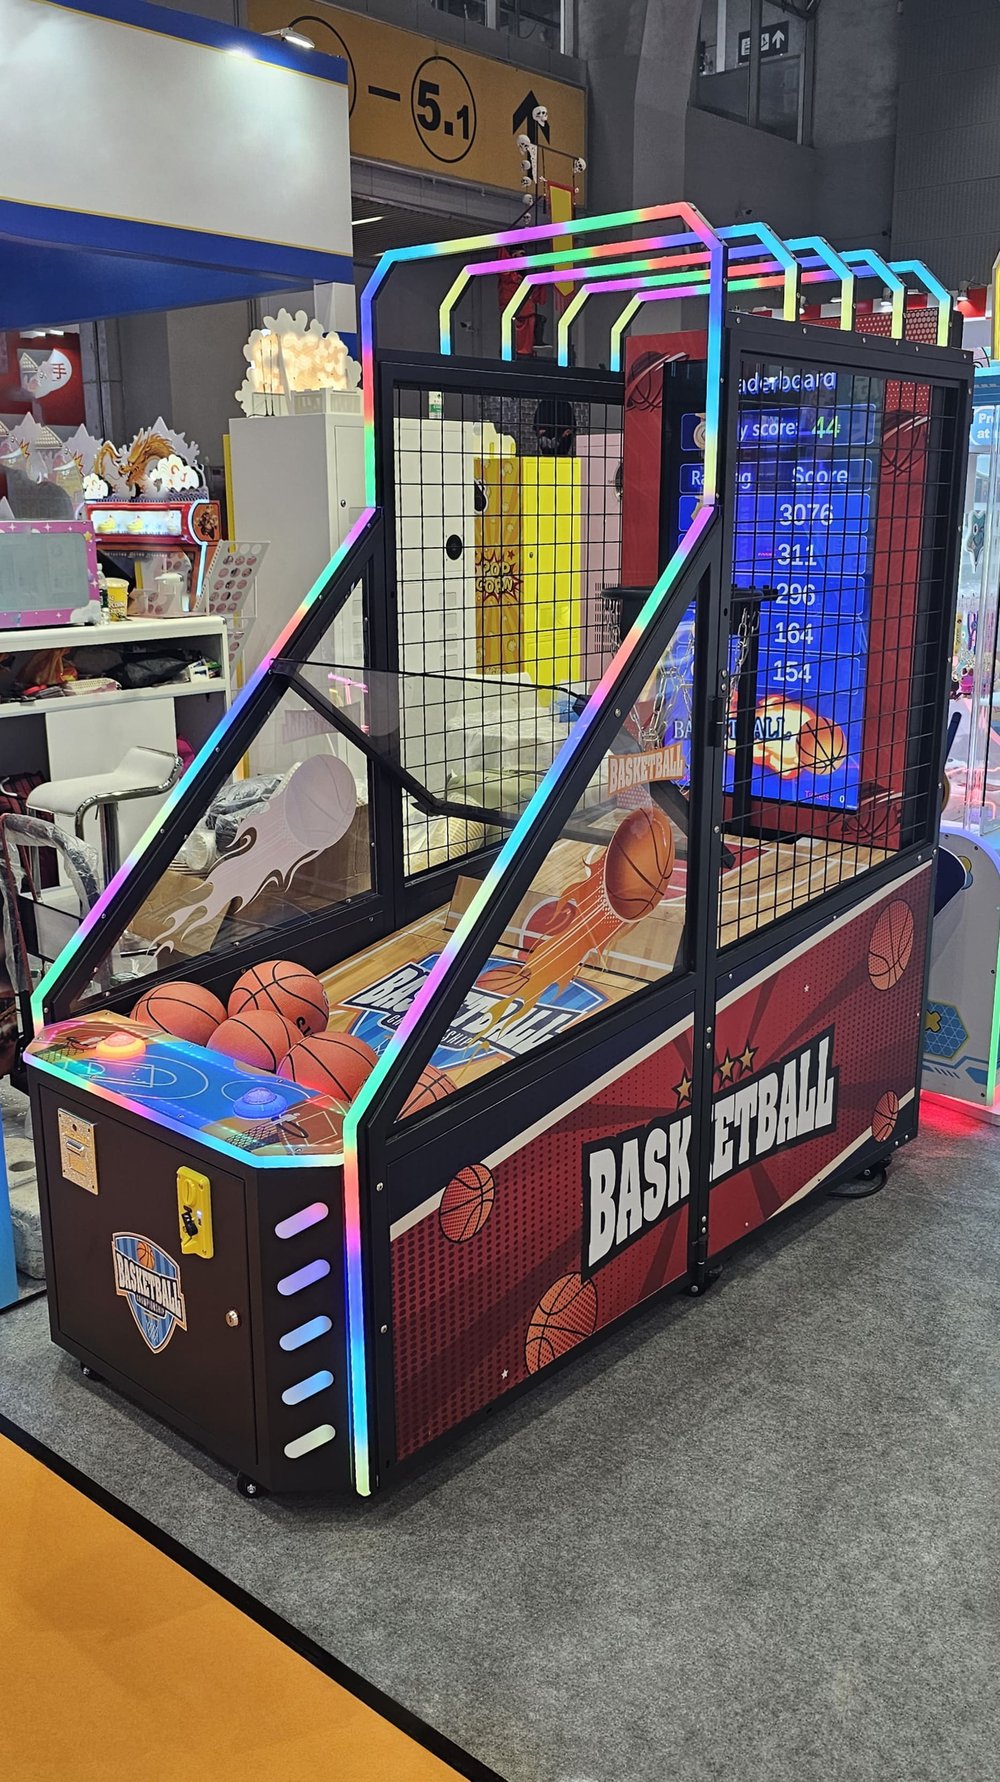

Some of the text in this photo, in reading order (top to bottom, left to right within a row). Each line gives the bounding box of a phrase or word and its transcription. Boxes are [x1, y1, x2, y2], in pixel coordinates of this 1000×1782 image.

[417, 79, 469, 141] 5.1
[811, 415, 840, 439] 44
[792, 466, 848, 486] Score
[779, 503, 833, 526] 3076
[776, 543, 817, 566] 311
[776, 583, 816, 606] 296
[774, 621, 814, 645] 164
[773, 660, 812, 683] 154
[609, 744, 684, 794] BASKETBALL
[588, 1036, 835, 1267] BASKETBALL
[116, 1253, 182, 1319] BASKETBALL
